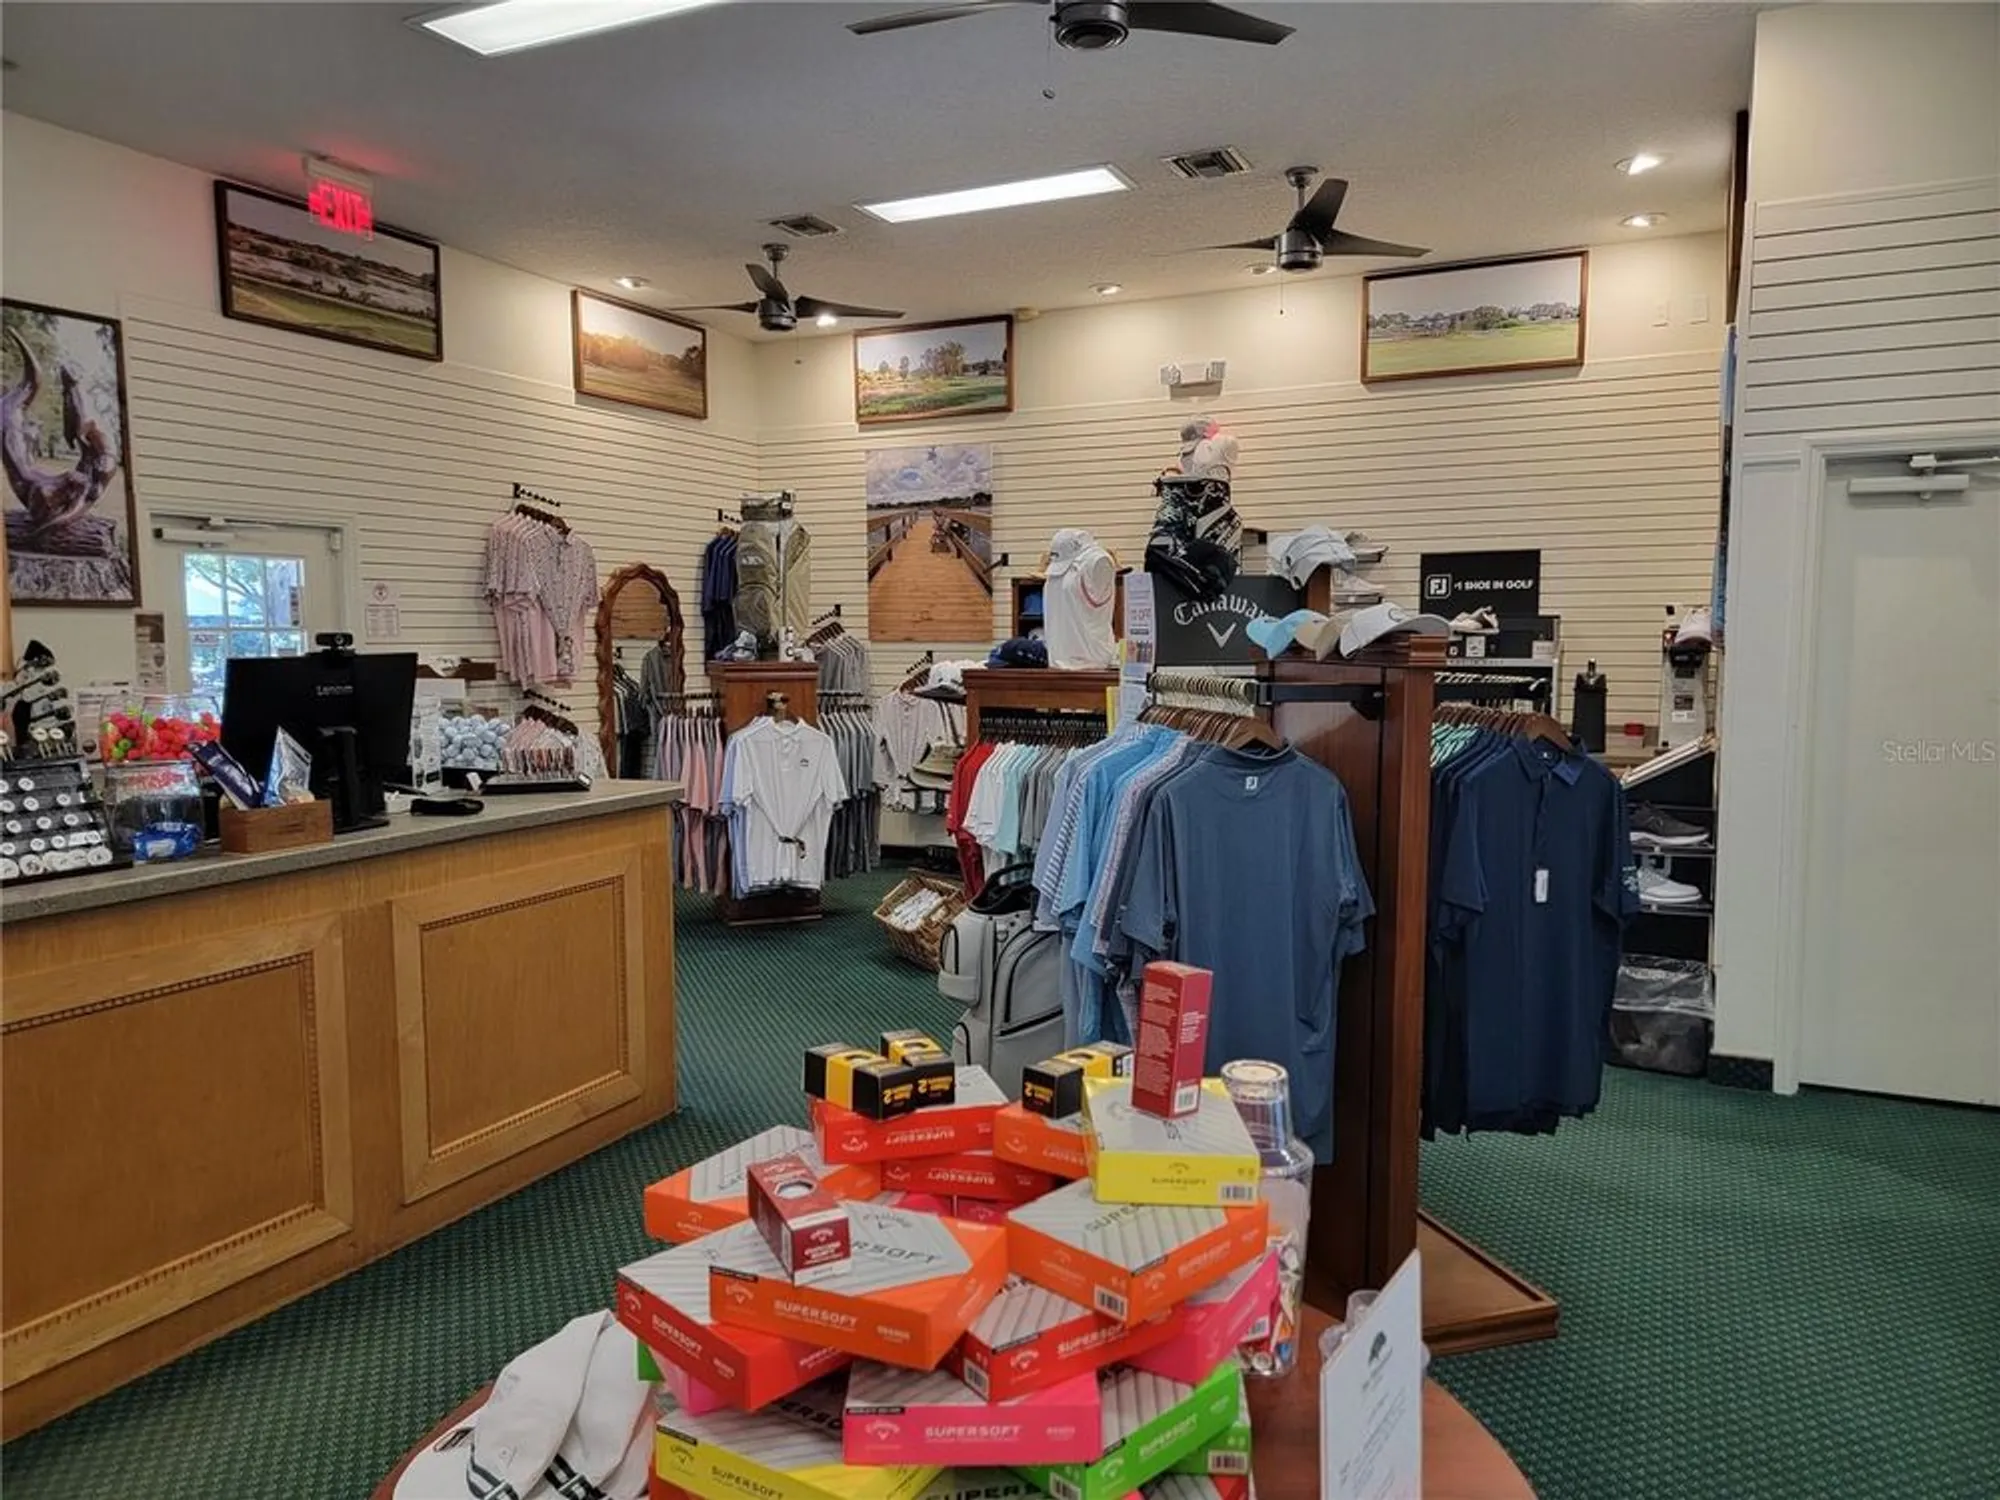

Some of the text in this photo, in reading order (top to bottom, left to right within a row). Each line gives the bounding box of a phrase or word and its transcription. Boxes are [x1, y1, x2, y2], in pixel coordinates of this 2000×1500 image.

[319, 182, 362, 235] EXIT
[1429, 577, 1447, 595] FJ
[1464, 579, 1491, 591] SHOE
[1492, 580, 1504, 590] IN
[1505, 579, 1534, 590] GOLF
[852, 1239, 938, 1264] RSOFT
[773, 1299, 858, 1328] SUPERSOFT
[651, 1313, 703, 1352] SUPERSOFT
[1057, 1322, 1126, 1354] SUPERSOF
[925, 1424, 1023, 1438] SUPERSOFT
[711, 1465, 785, 1500] SUPERSOFT
